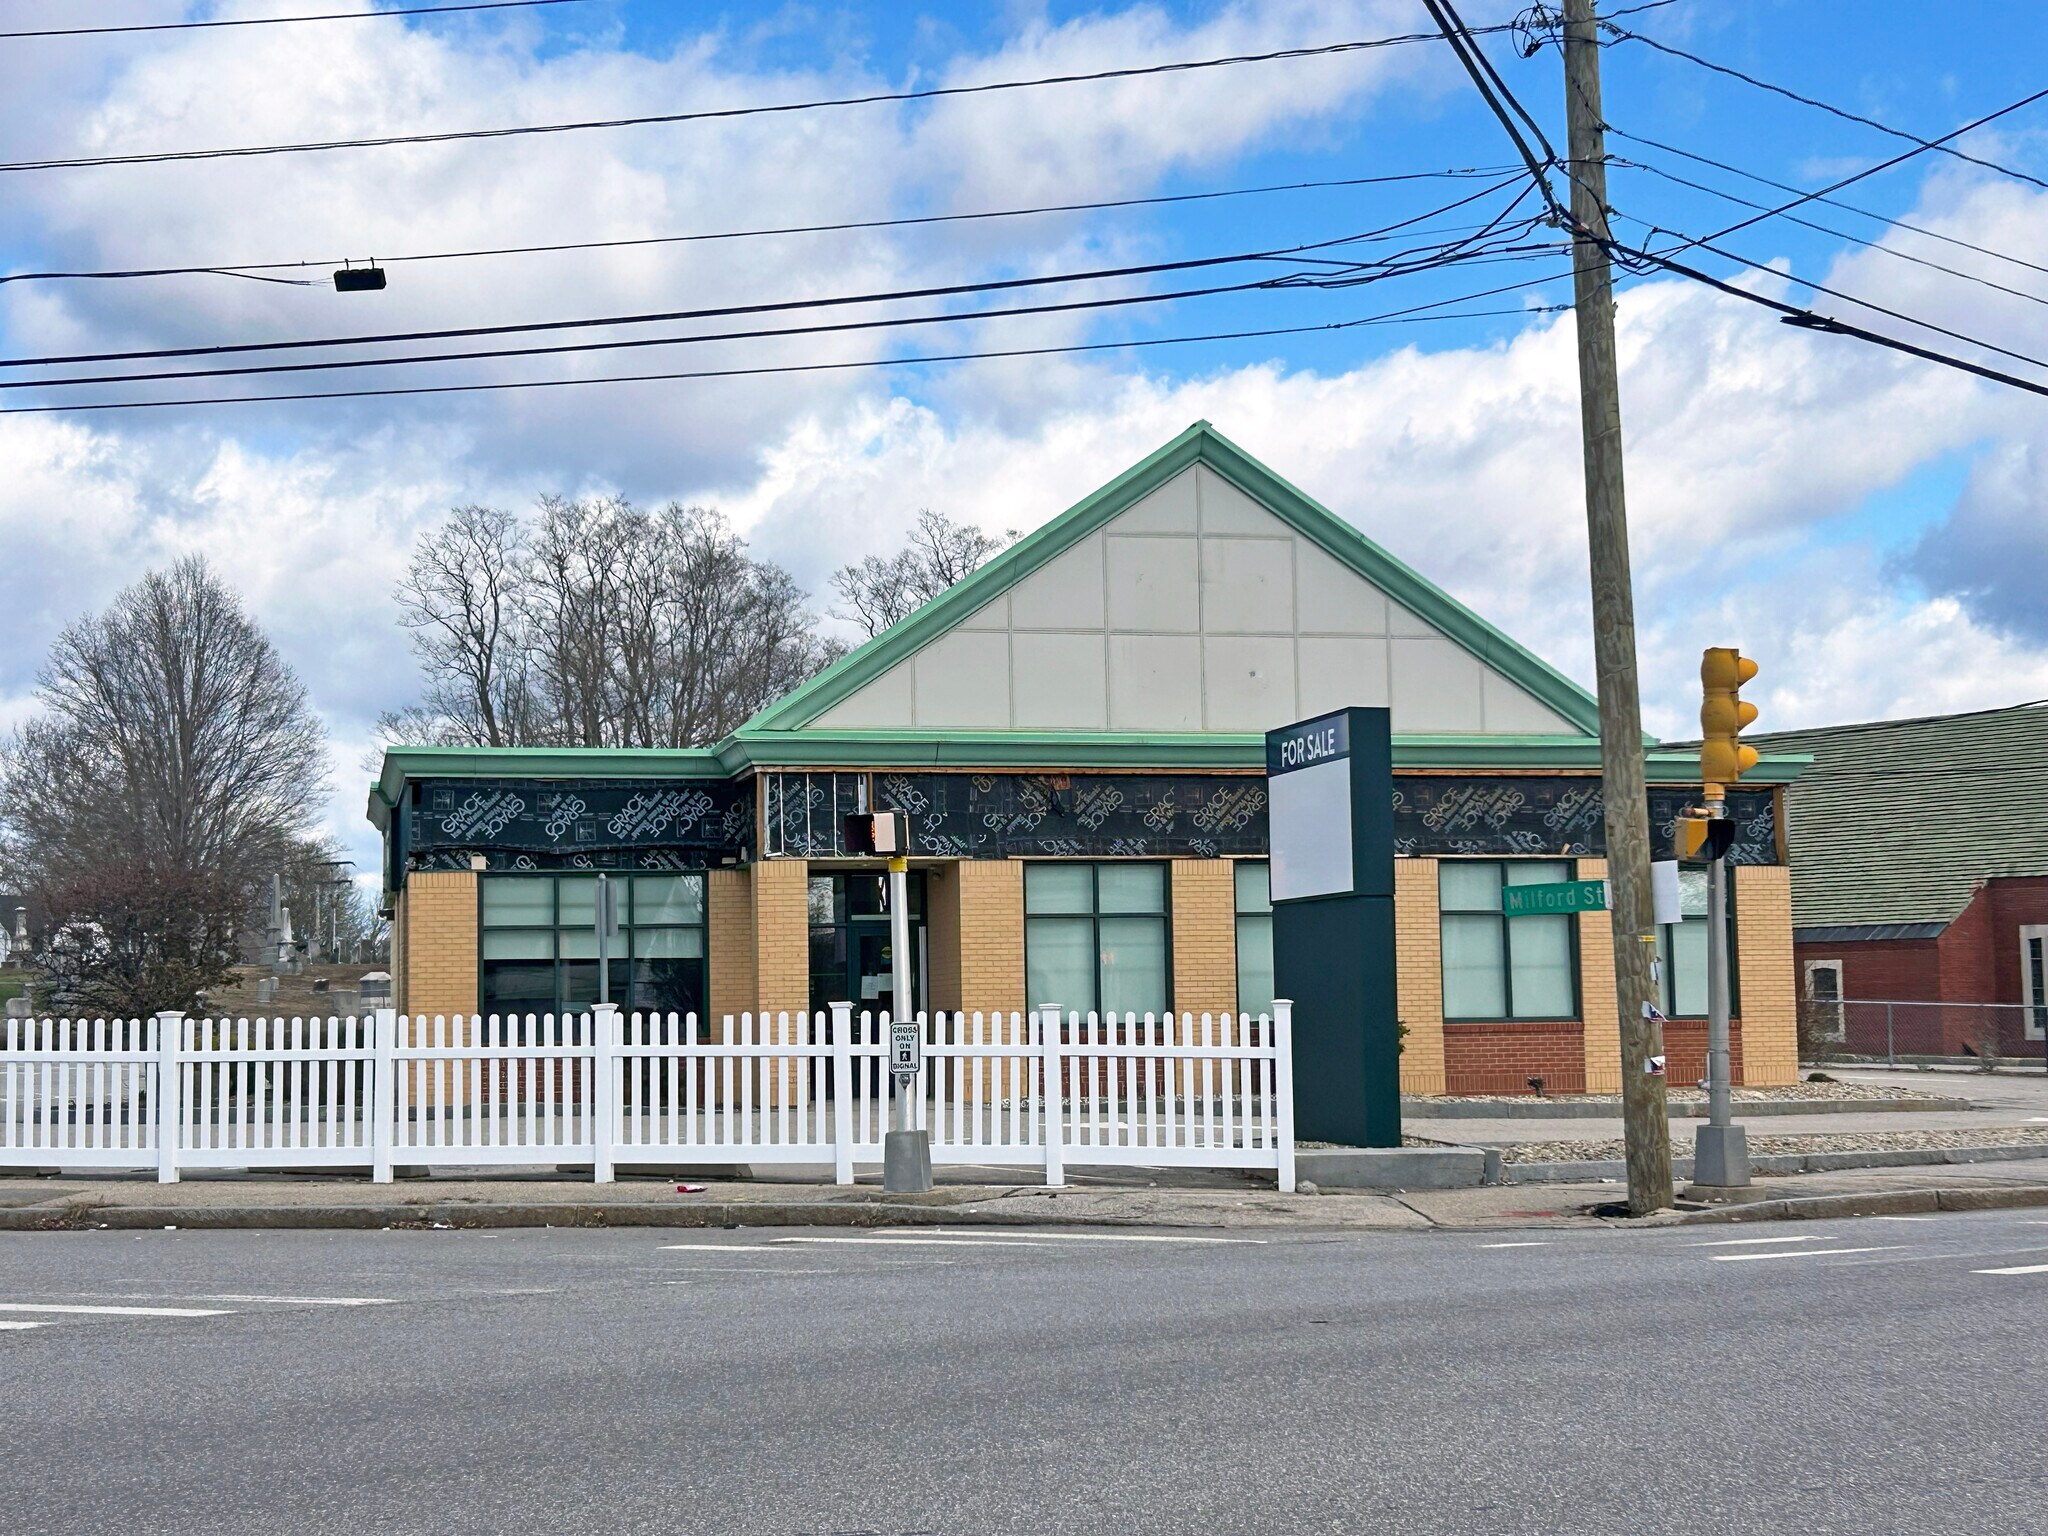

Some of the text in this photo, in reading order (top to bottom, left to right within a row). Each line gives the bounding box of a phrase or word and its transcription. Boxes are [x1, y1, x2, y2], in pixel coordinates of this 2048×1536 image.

[1281, 728, 1335, 767] FOR SALE
[441, 792, 486, 833] GRACE
[485, 798, 526, 840] GRACE
[607, 792, 648, 834] GRACE
[1085, 791, 1124, 832] GRACE
[1193, 786, 1232, 827] GRACE
[1232, 791, 1268, 833] GRACE
[1423, 786, 1458, 827] GRACE
[1543, 786, 1578, 827] GRACE
[1508, 887, 1603, 910] Milford St
[895, 1034, 915, 1042] ONLY
[899, 1042, 911, 1050] ON
